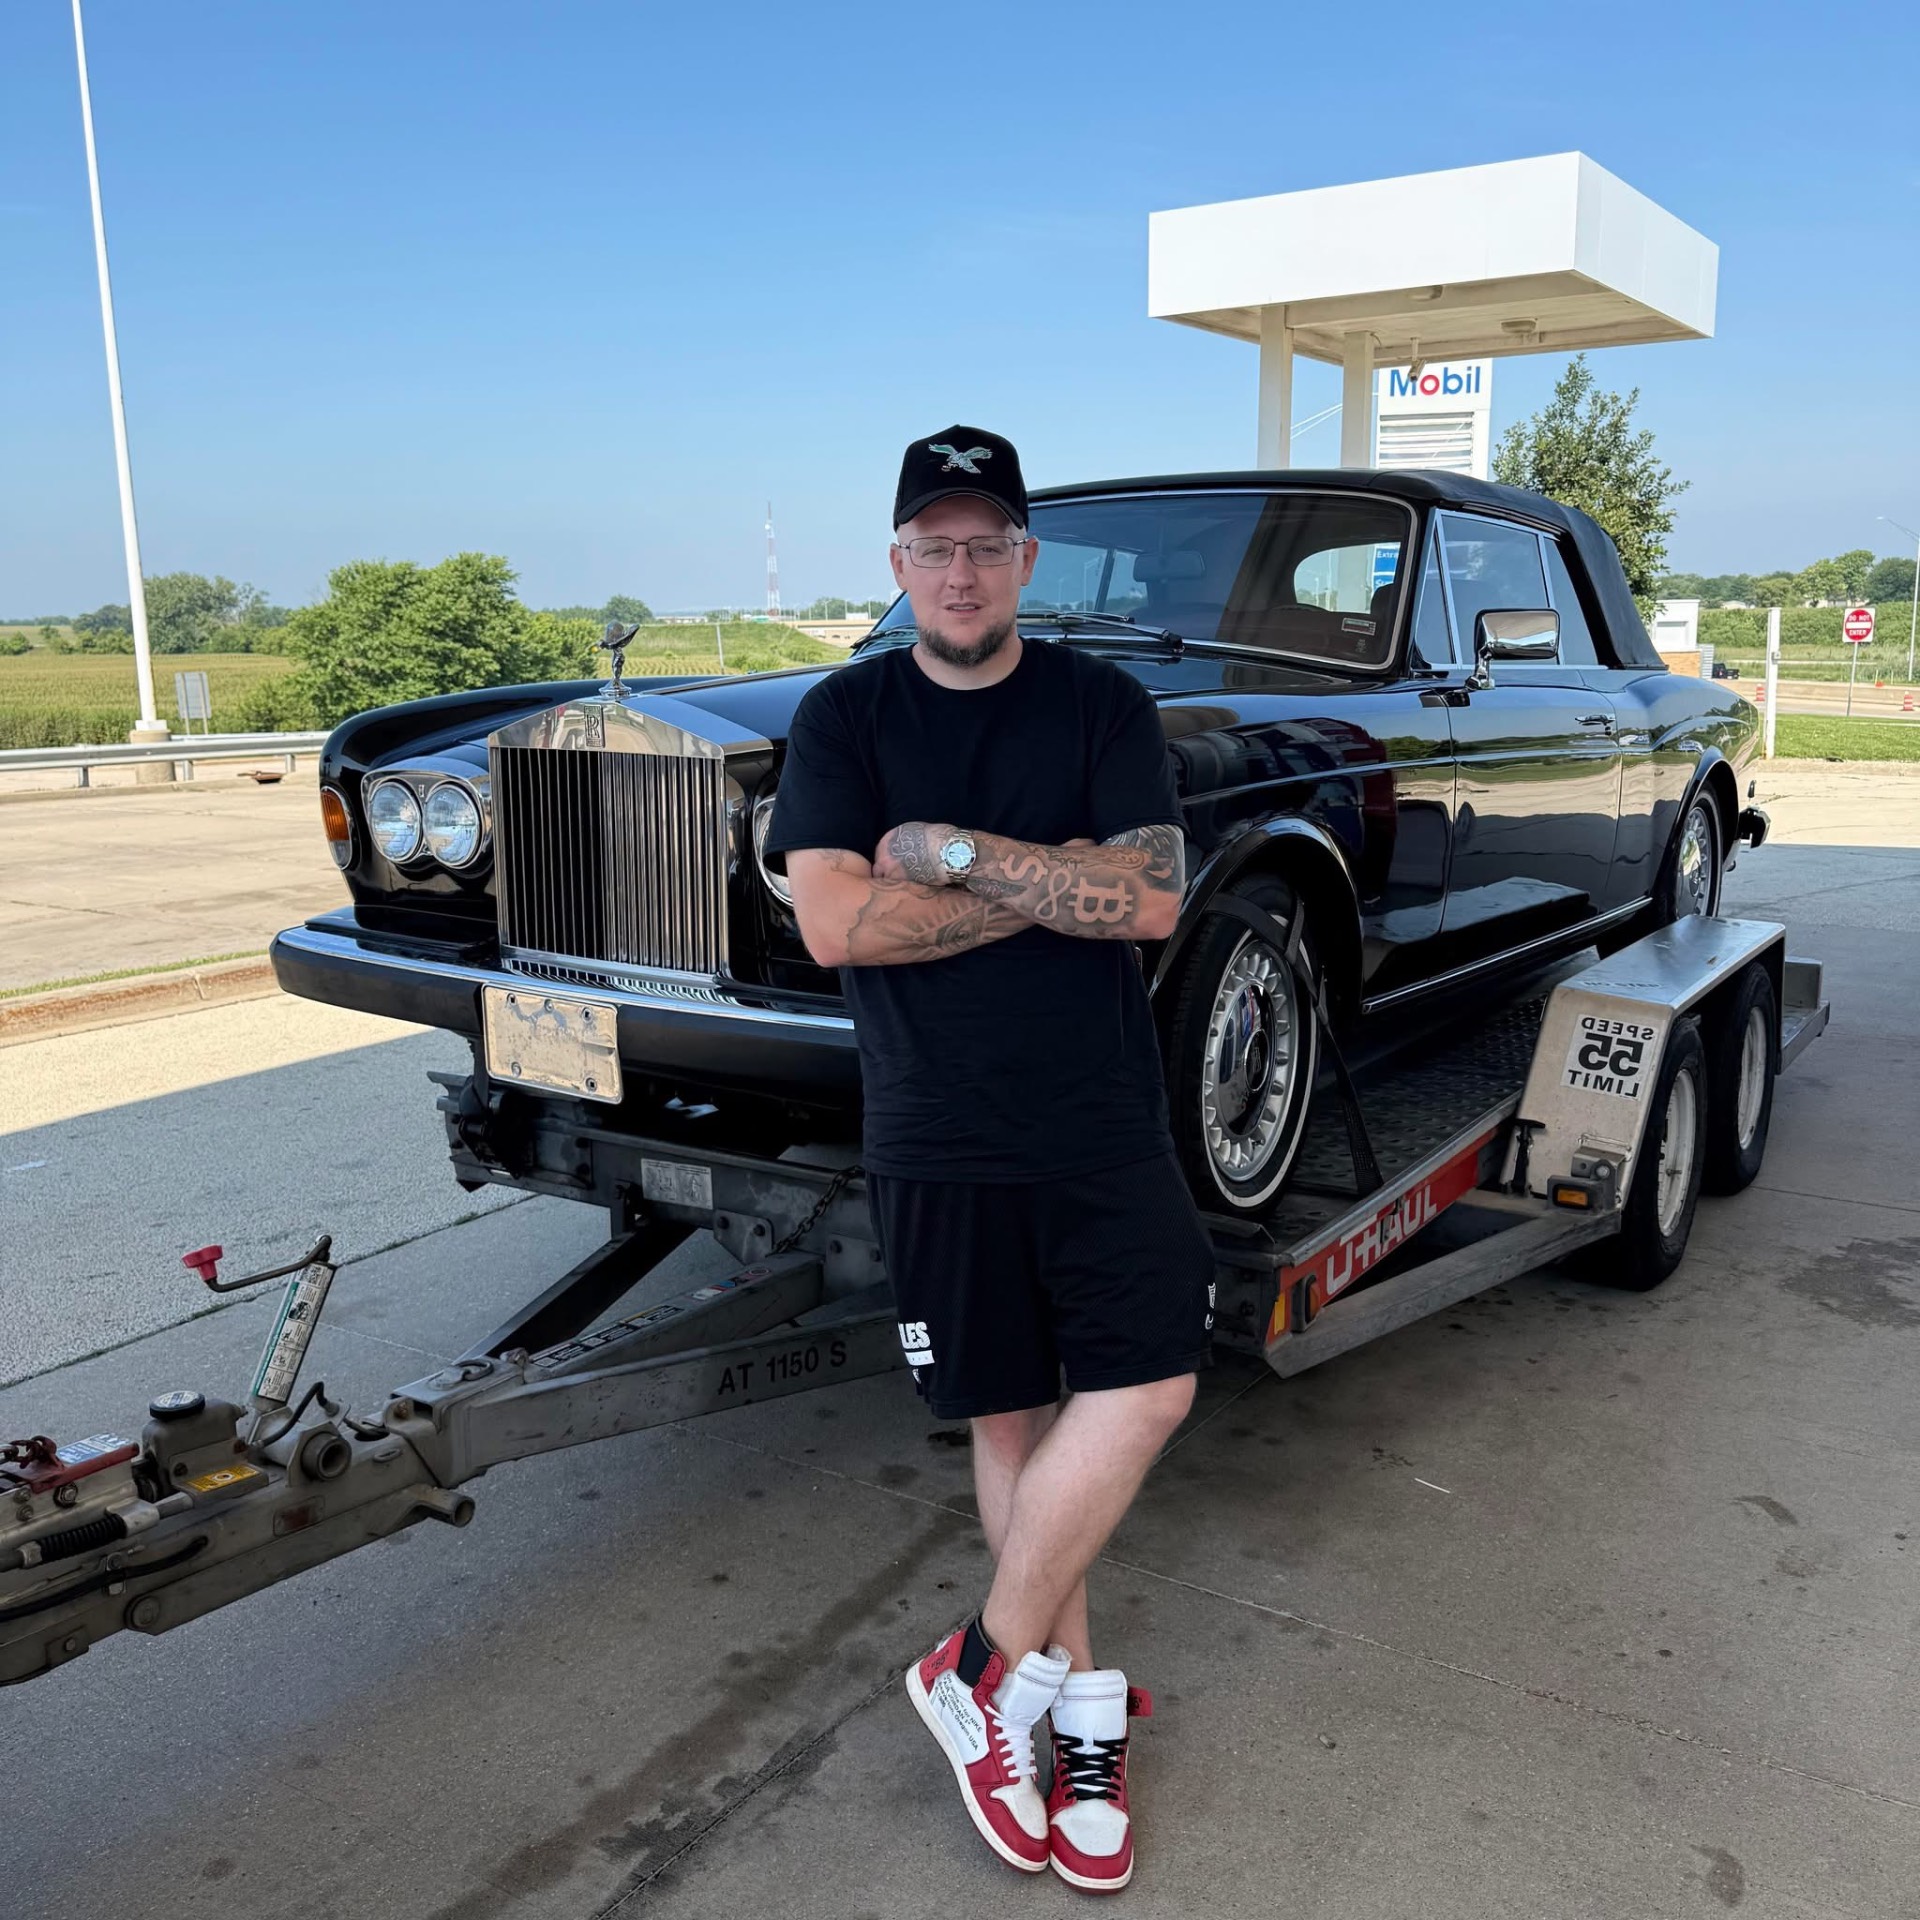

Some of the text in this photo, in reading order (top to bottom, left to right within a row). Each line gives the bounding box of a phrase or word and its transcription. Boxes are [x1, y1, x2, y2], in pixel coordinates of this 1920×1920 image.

[1390, 366, 1481, 397] Mobil
[898, 1321, 930, 1349] LES
[718, 1341, 847, 1395] AT 1150 S
[954, 1714, 970, 1736] Oregon
[968, 1735, 979, 1751] USA
[969, 1717, 983, 1733] NIKE
